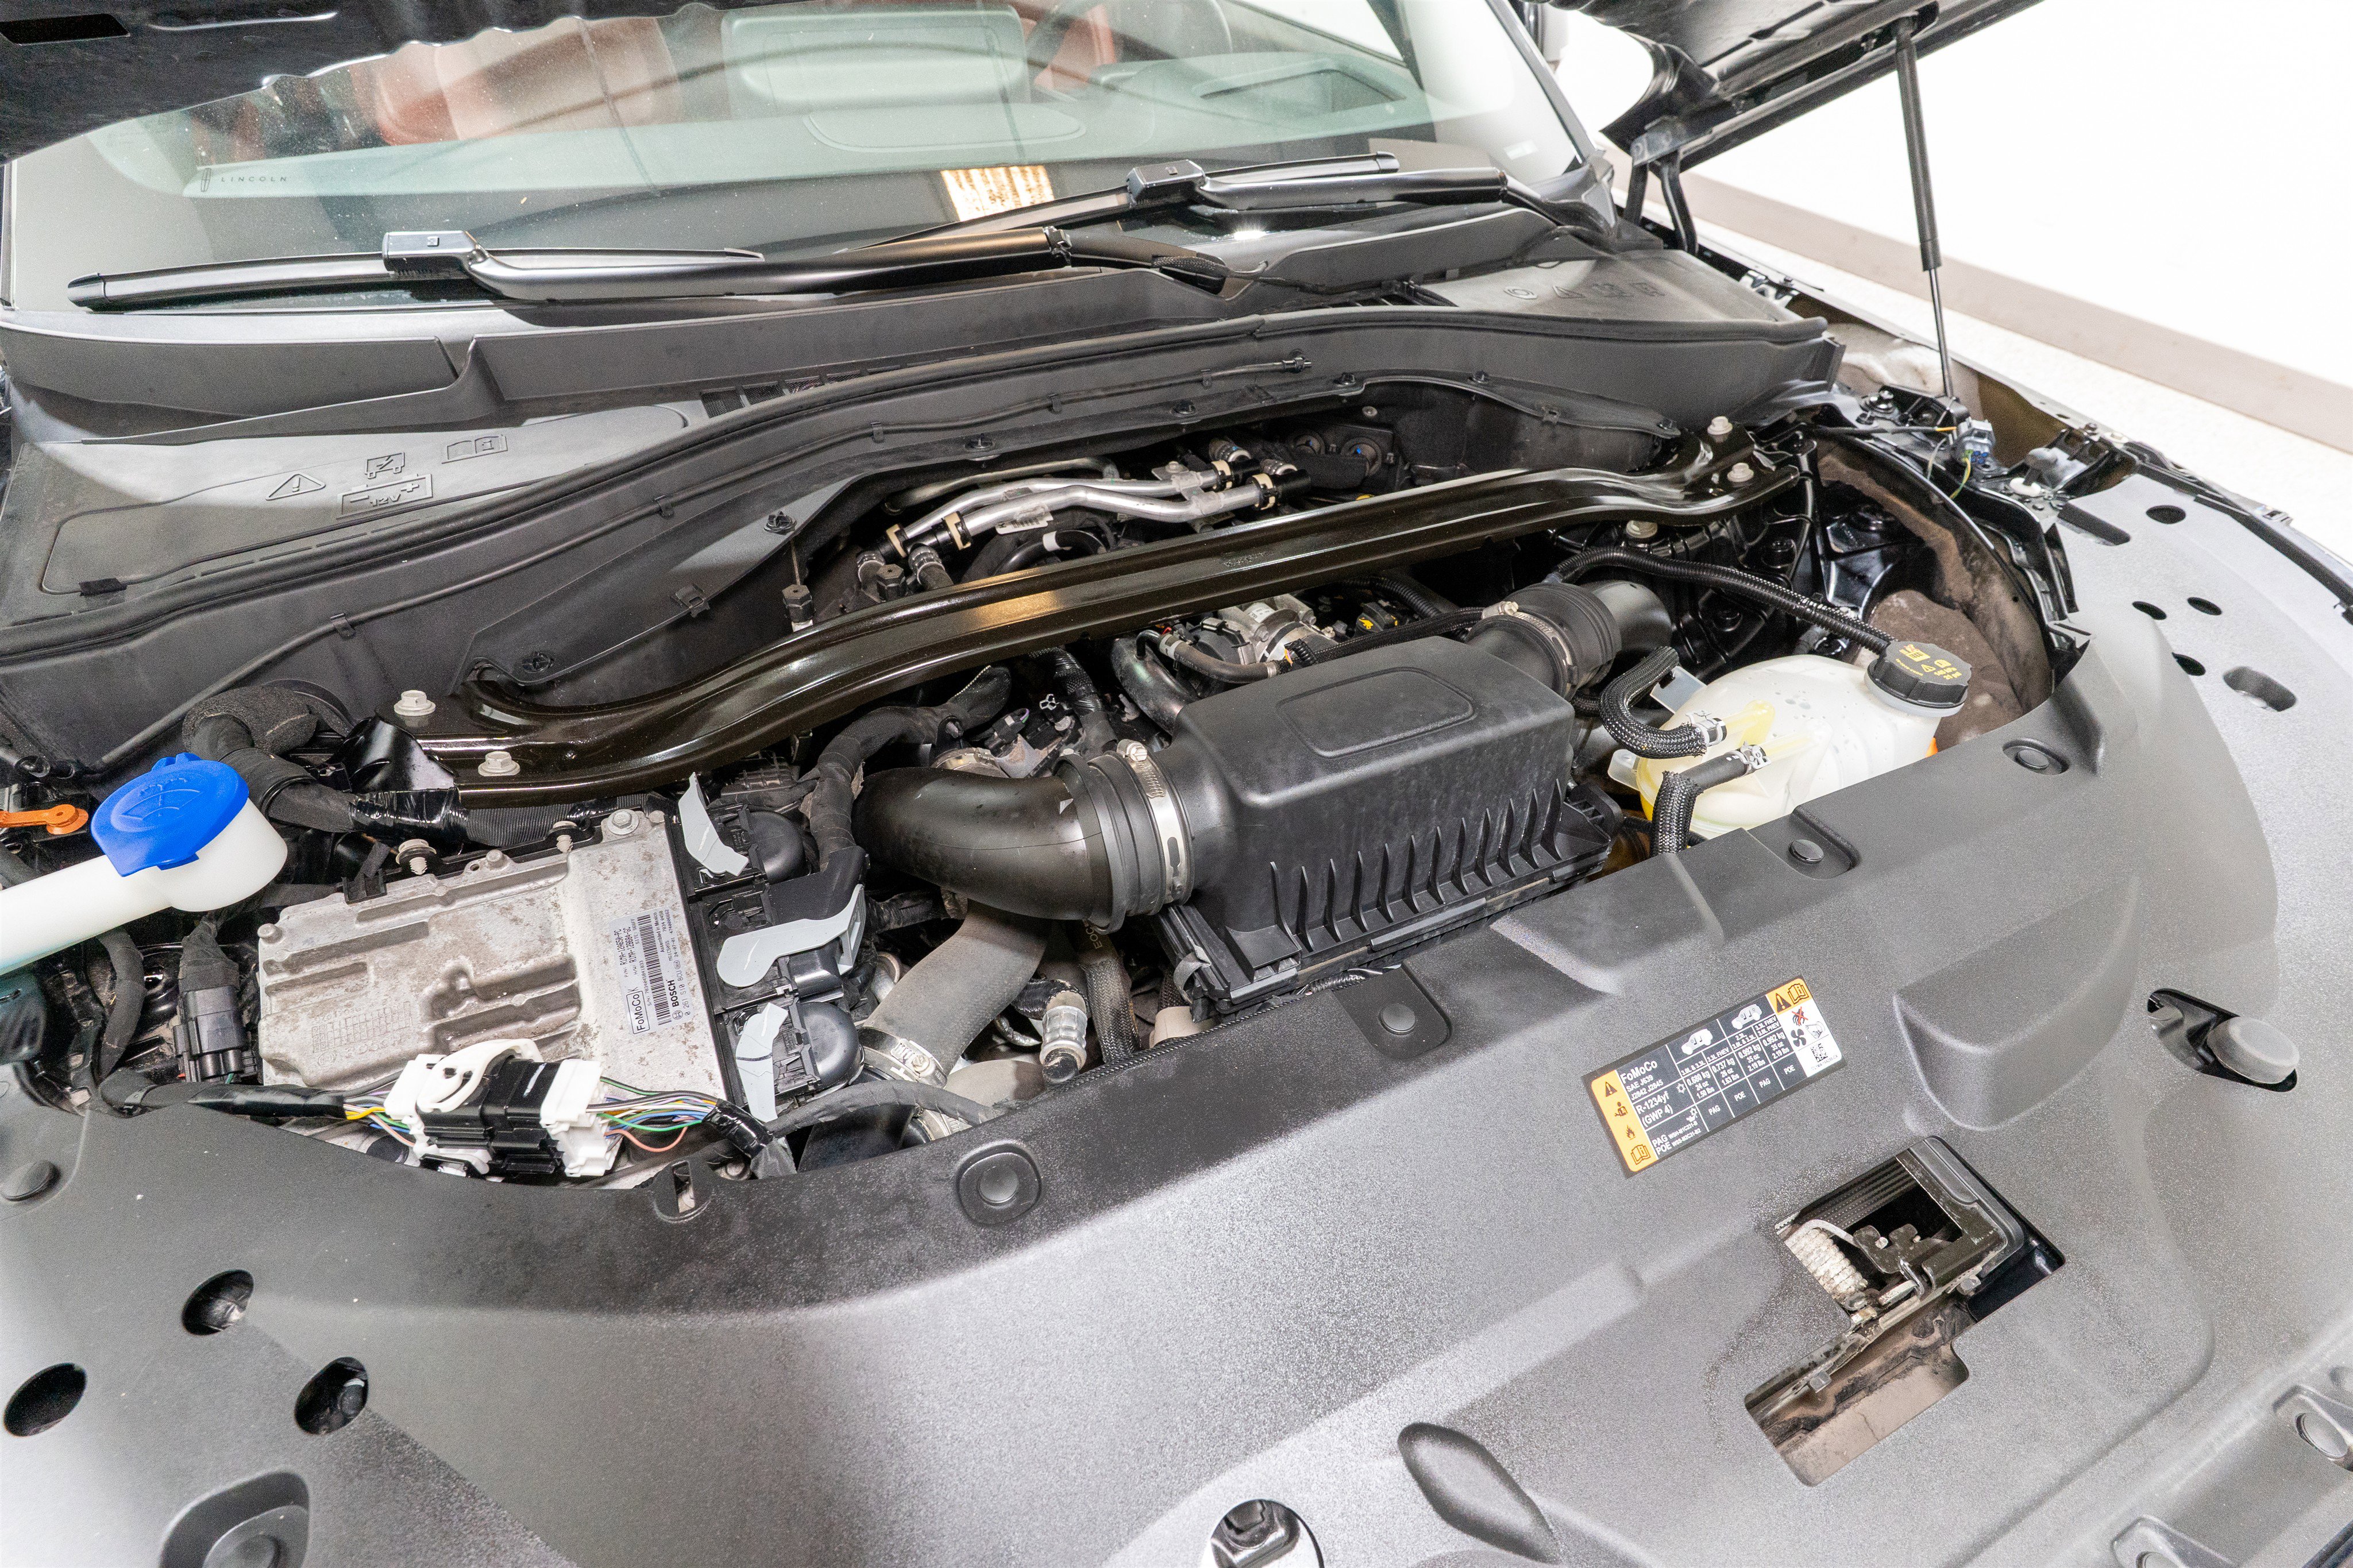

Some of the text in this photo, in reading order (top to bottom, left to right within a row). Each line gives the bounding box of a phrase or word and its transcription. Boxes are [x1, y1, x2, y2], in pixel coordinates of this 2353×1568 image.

[370, 494, 401, 507] 12V
[657, 931, 665, 952] Assembled
[668, 980, 679, 1007] BOSCH
[632, 994, 646, 1030] FoMoCo
[1764, 1017, 1777, 1025] FHEV
[1766, 1022, 1779, 1030] PHEV
[1762, 1031, 1785, 1046] 0.992 kg
[1716, 1048, 1729, 1057] FHEV
[1738, 1043, 1761, 1059] 0.992 kg
[1772, 1050, 1783, 1059] 2.19
[1619, 1059, 1658, 1083] FoMoCo
[1711, 1057, 1735, 1073] 0.737 kg
[1747, 1063, 1758, 1071] 2.19
[1784, 1065, 1795, 1074] POE
[1626, 1075, 1653, 1092] SAE J639
[1686, 1069, 1711, 1086] 0.680 kg
[1721, 1077, 1732, 1086] 1.63
[1759, 1078, 1770, 1087] PAG
[1630, 1080, 1664, 1100] J2842 J2845
[1696, 1086, 1714, 1099] 1.50 lbs
[1734, 1091, 1745, 1101] POE
[1635, 1091, 1671, 1115] R-1234yf
[1641, 1104, 1673, 1127] (GWP 4)
[1708, 1105, 1721, 1115] PAG
[1652, 1134, 1668, 1147] PAG
[1656, 1142, 1671, 1154] POE
